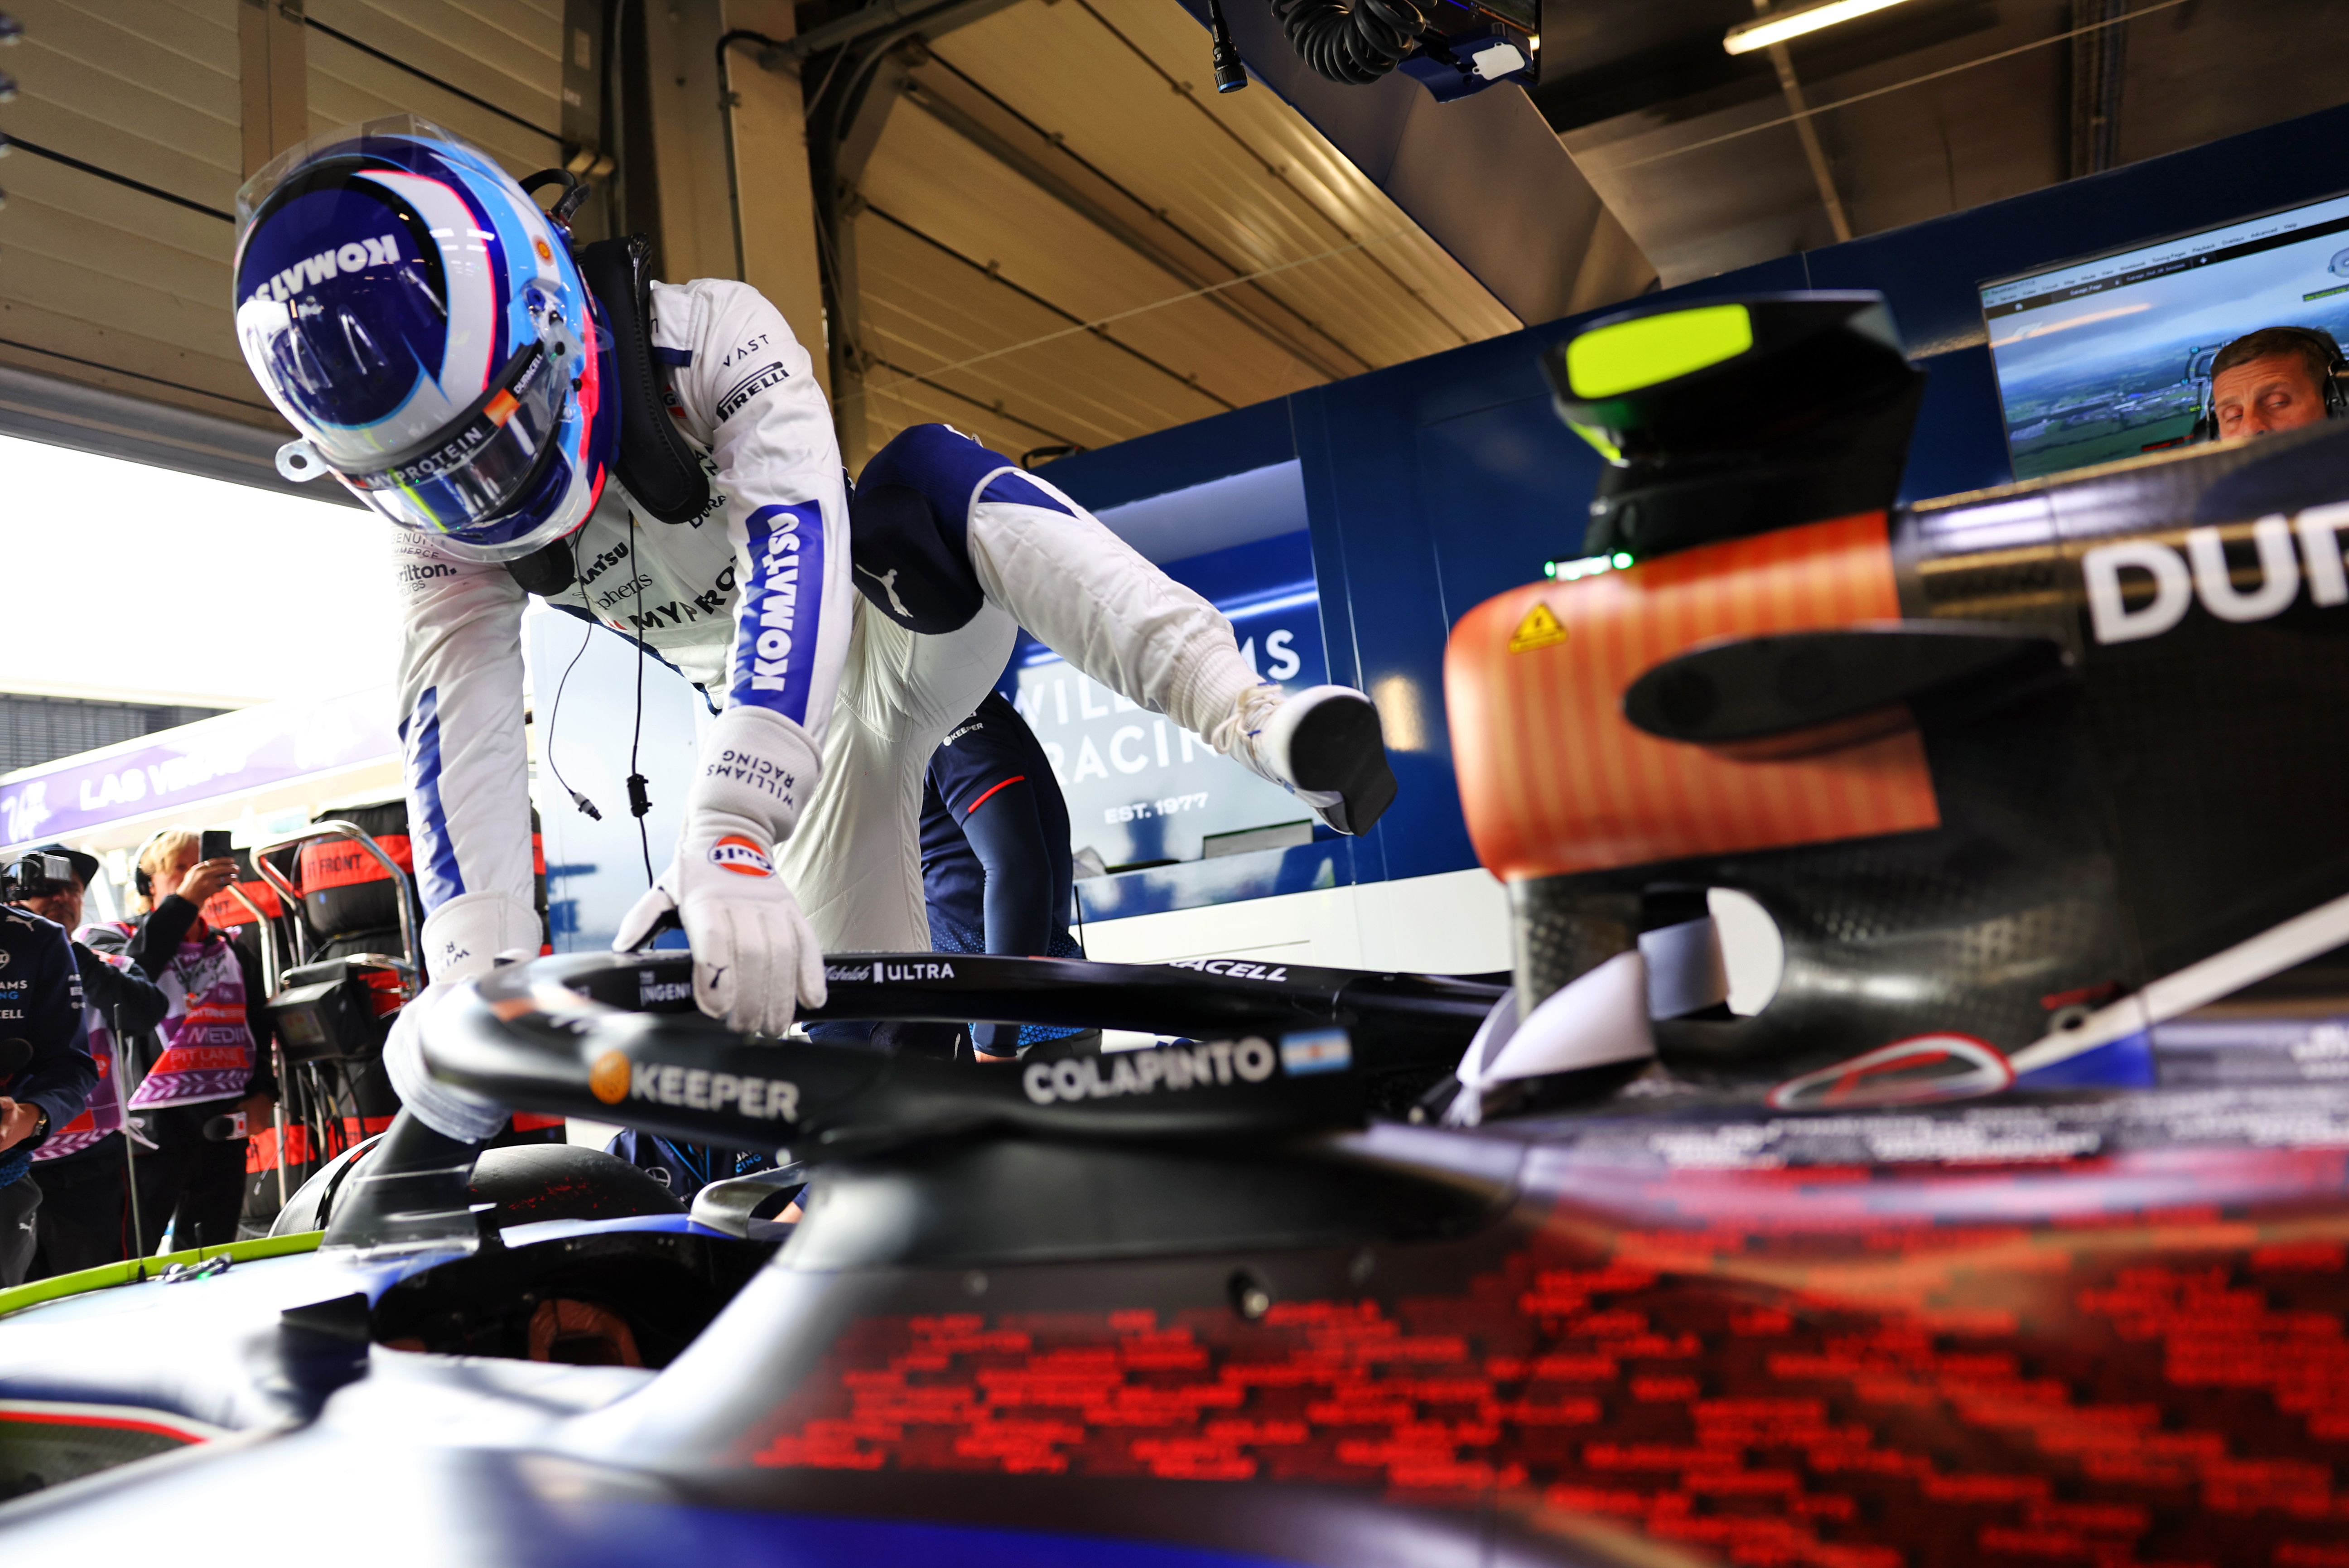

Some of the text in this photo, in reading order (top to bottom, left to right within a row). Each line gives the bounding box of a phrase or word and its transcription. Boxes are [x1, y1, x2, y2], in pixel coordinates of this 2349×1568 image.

[724, 334, 769, 367] VAST
[716, 361, 790, 423] PIRELLI
[366, 427, 483, 488] MYPROTEIN
[752, 512, 800, 691] KOMATSU
[79, 769, 147, 812] LAS
[707, 764, 793, 810] WILLIAMS
[723, 750, 795, 789] RACING
[1104, 791, 1208, 825] EST. 1977
[319, 853, 362, 875] FRONT
[887, 963, 955, 981] ULTRA
[1022, 1035, 1277, 1105] COLAPINTO
[630, 1061, 800, 1124] KEEPER
